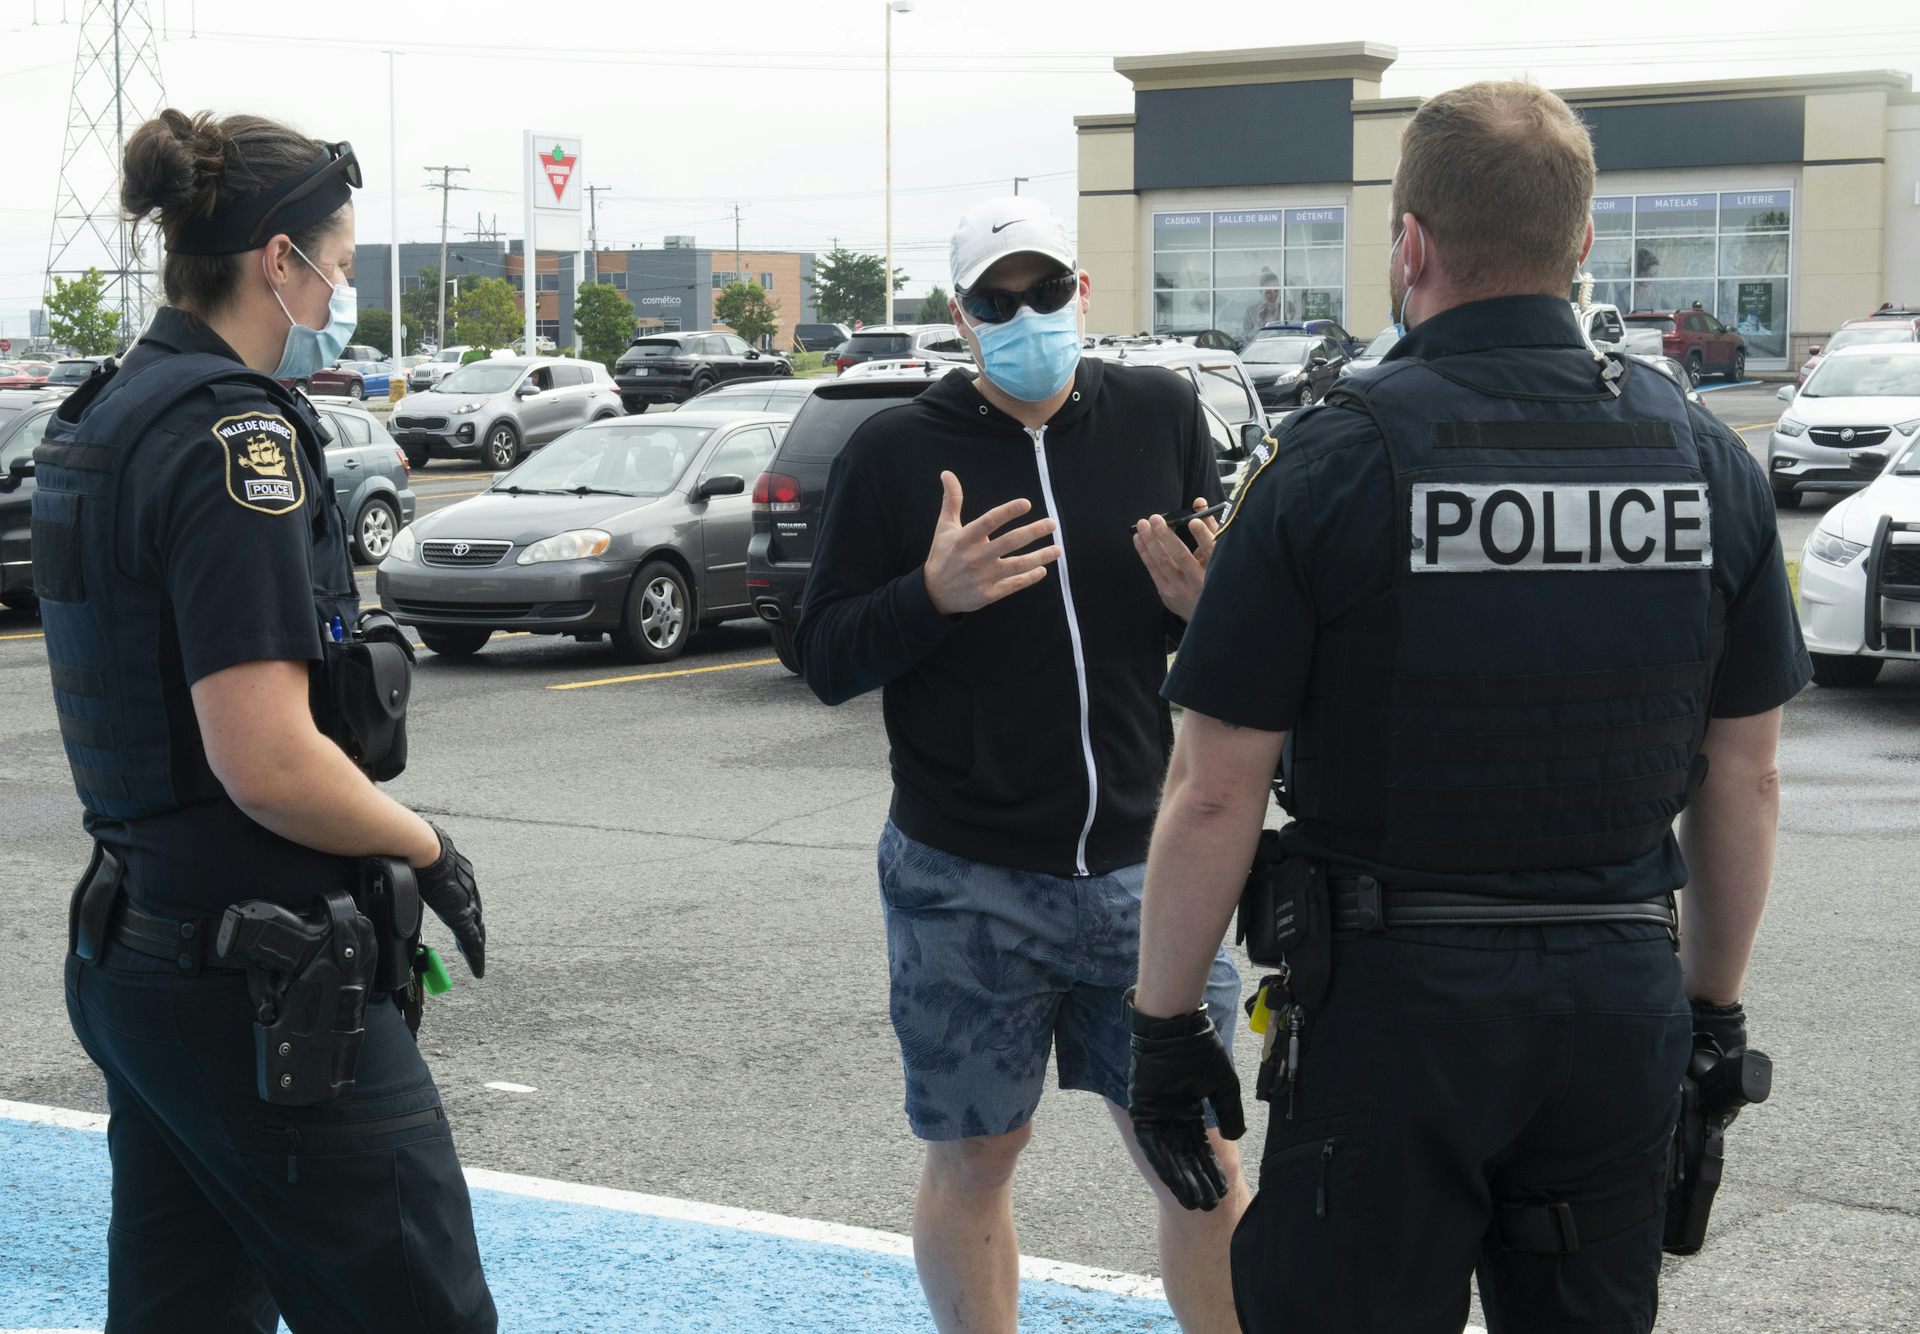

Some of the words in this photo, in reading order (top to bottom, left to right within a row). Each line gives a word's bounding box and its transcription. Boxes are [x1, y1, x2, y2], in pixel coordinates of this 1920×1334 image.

[1655, 198, 1698, 208] MATELAS
[1737, 195, 1774, 205] LITERIE
[1165, 216, 1201, 225] CADEAUX
[1218, 214, 1243, 224] SALLE
[1245, 214, 1257, 223] DE
[1258, 213, 1278, 223] BAIN
[1296, 211, 1333, 221] DÉTENTE
[642, 295, 682, 304] cosmético
[219, 423, 246, 438] VILLE
[244, 420, 259, 431] DE
[258, 420, 291, 440] QUÉBEC
[253, 484, 289, 495] POLICE
[1426, 488, 1702, 566] POLICE
